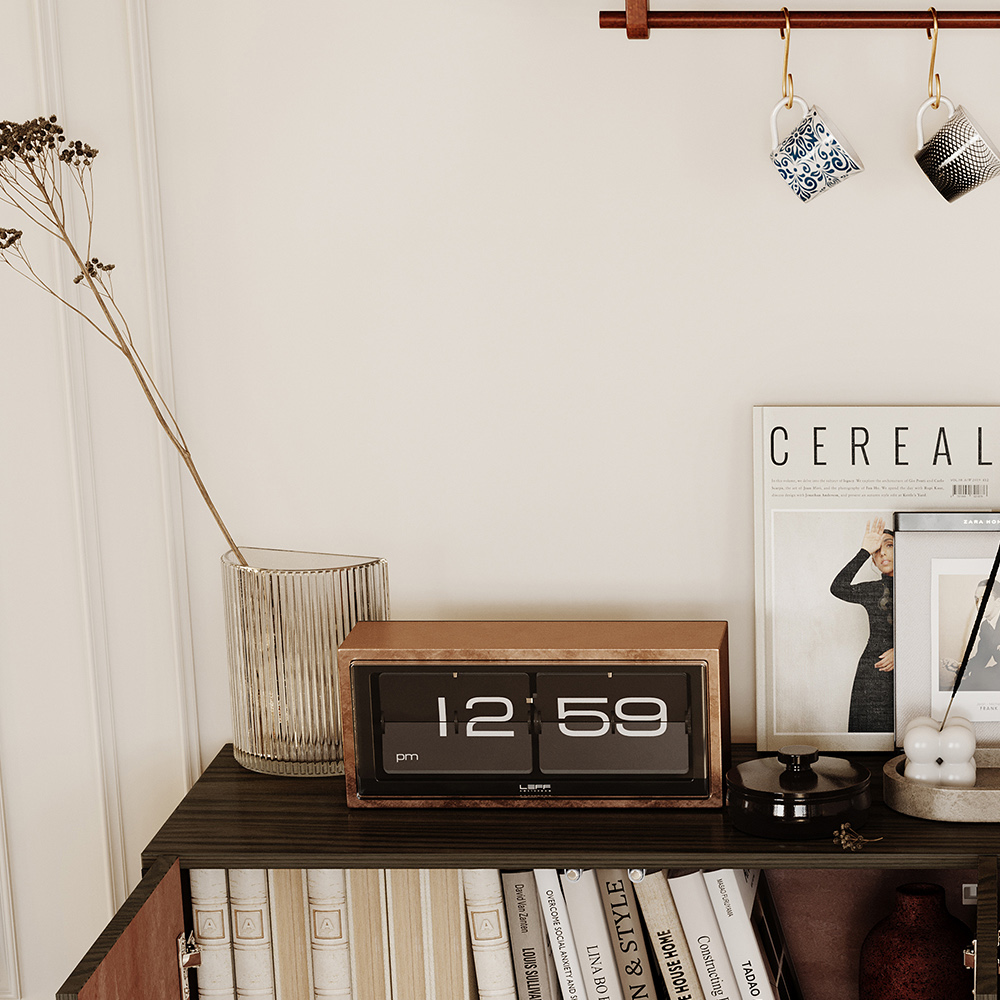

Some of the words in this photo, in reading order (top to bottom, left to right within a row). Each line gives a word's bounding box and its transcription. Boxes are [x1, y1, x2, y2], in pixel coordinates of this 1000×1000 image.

[770, 426, 993, 466] CEREAL
[437, 696, 515, 737] 12
[557, 696, 667, 737] 59
[396, 752, 419, 763] pm
[515, 884, 525, 900] David
[518, 902, 526, 912] Van
[519, 912, 528, 934] Zanten
[606, 880, 638, 952] STYLE
[522, 948, 537, 969] LOUIS
[546, 890, 560, 926] OVERCOME
[554, 926, 564, 950] SOCIAL
[560, 951, 572, 978] ANXIETY
[567, 978, 576, 994] AND
[657, 929, 678, 959] HOME
[586, 946, 602, 974] LINA
[594, 976, 608, 994] BO
[625, 958, 642, 976] &
[667, 960, 690, 994] HOUSE
[698, 936, 723, 996] Constructing
[742, 960, 760, 996] TADAO
